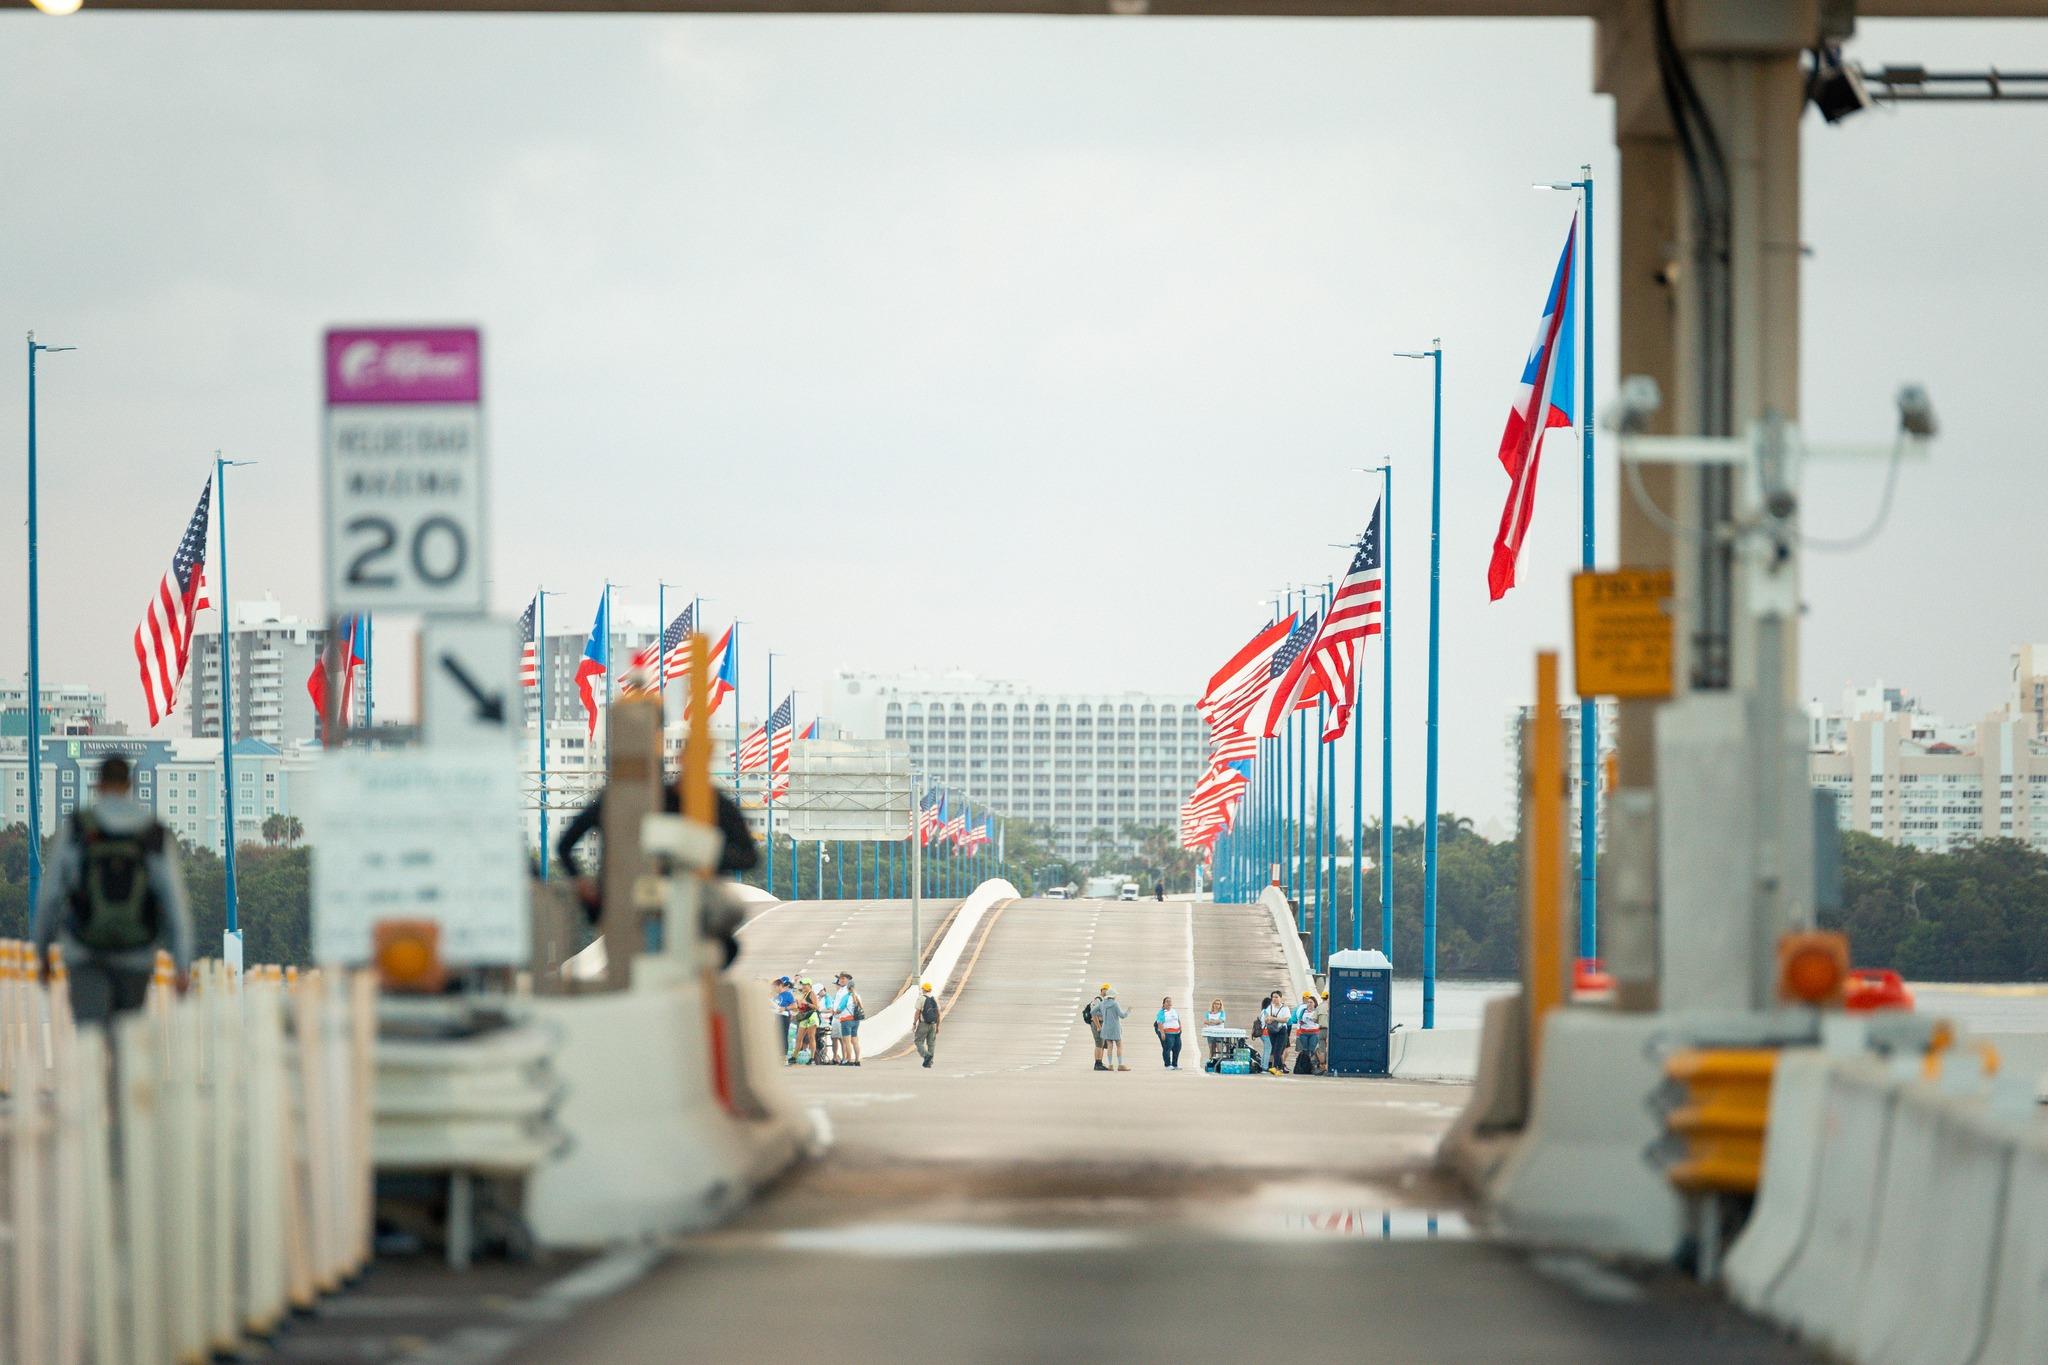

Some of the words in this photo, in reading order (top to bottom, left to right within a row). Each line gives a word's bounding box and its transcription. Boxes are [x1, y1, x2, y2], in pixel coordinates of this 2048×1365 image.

[345, 514, 468, 588] 20
[83, 742, 118, 750] EMBASSY
[121, 742, 148, 751] SUITES
